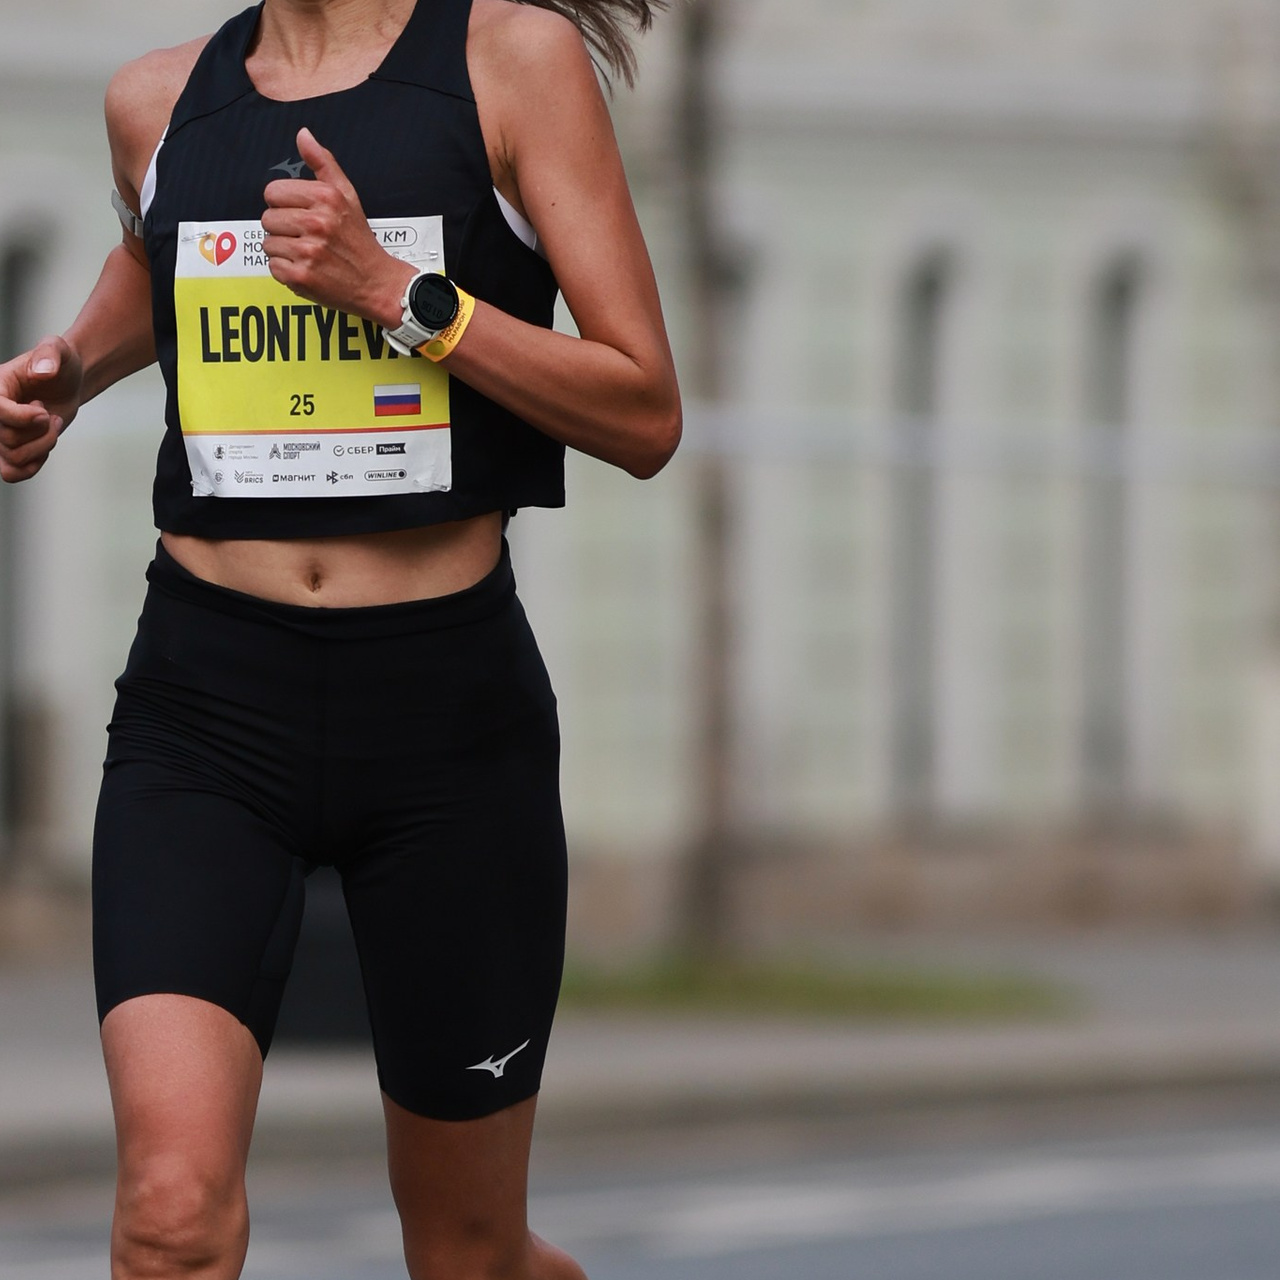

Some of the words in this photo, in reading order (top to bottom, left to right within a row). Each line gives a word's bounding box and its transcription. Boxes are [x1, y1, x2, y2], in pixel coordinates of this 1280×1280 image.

[200, 305, 422, 363] LEONTYEV
[289, 394, 315, 416] 25
[283, 441, 321, 452] МОСКОВСКИЙ
[347, 446, 374, 455] СБЕР
[378, 445, 402, 453] Прайм
[283, 451, 301, 460] СПОРТ
[367, 471, 398, 479] WINLINE
